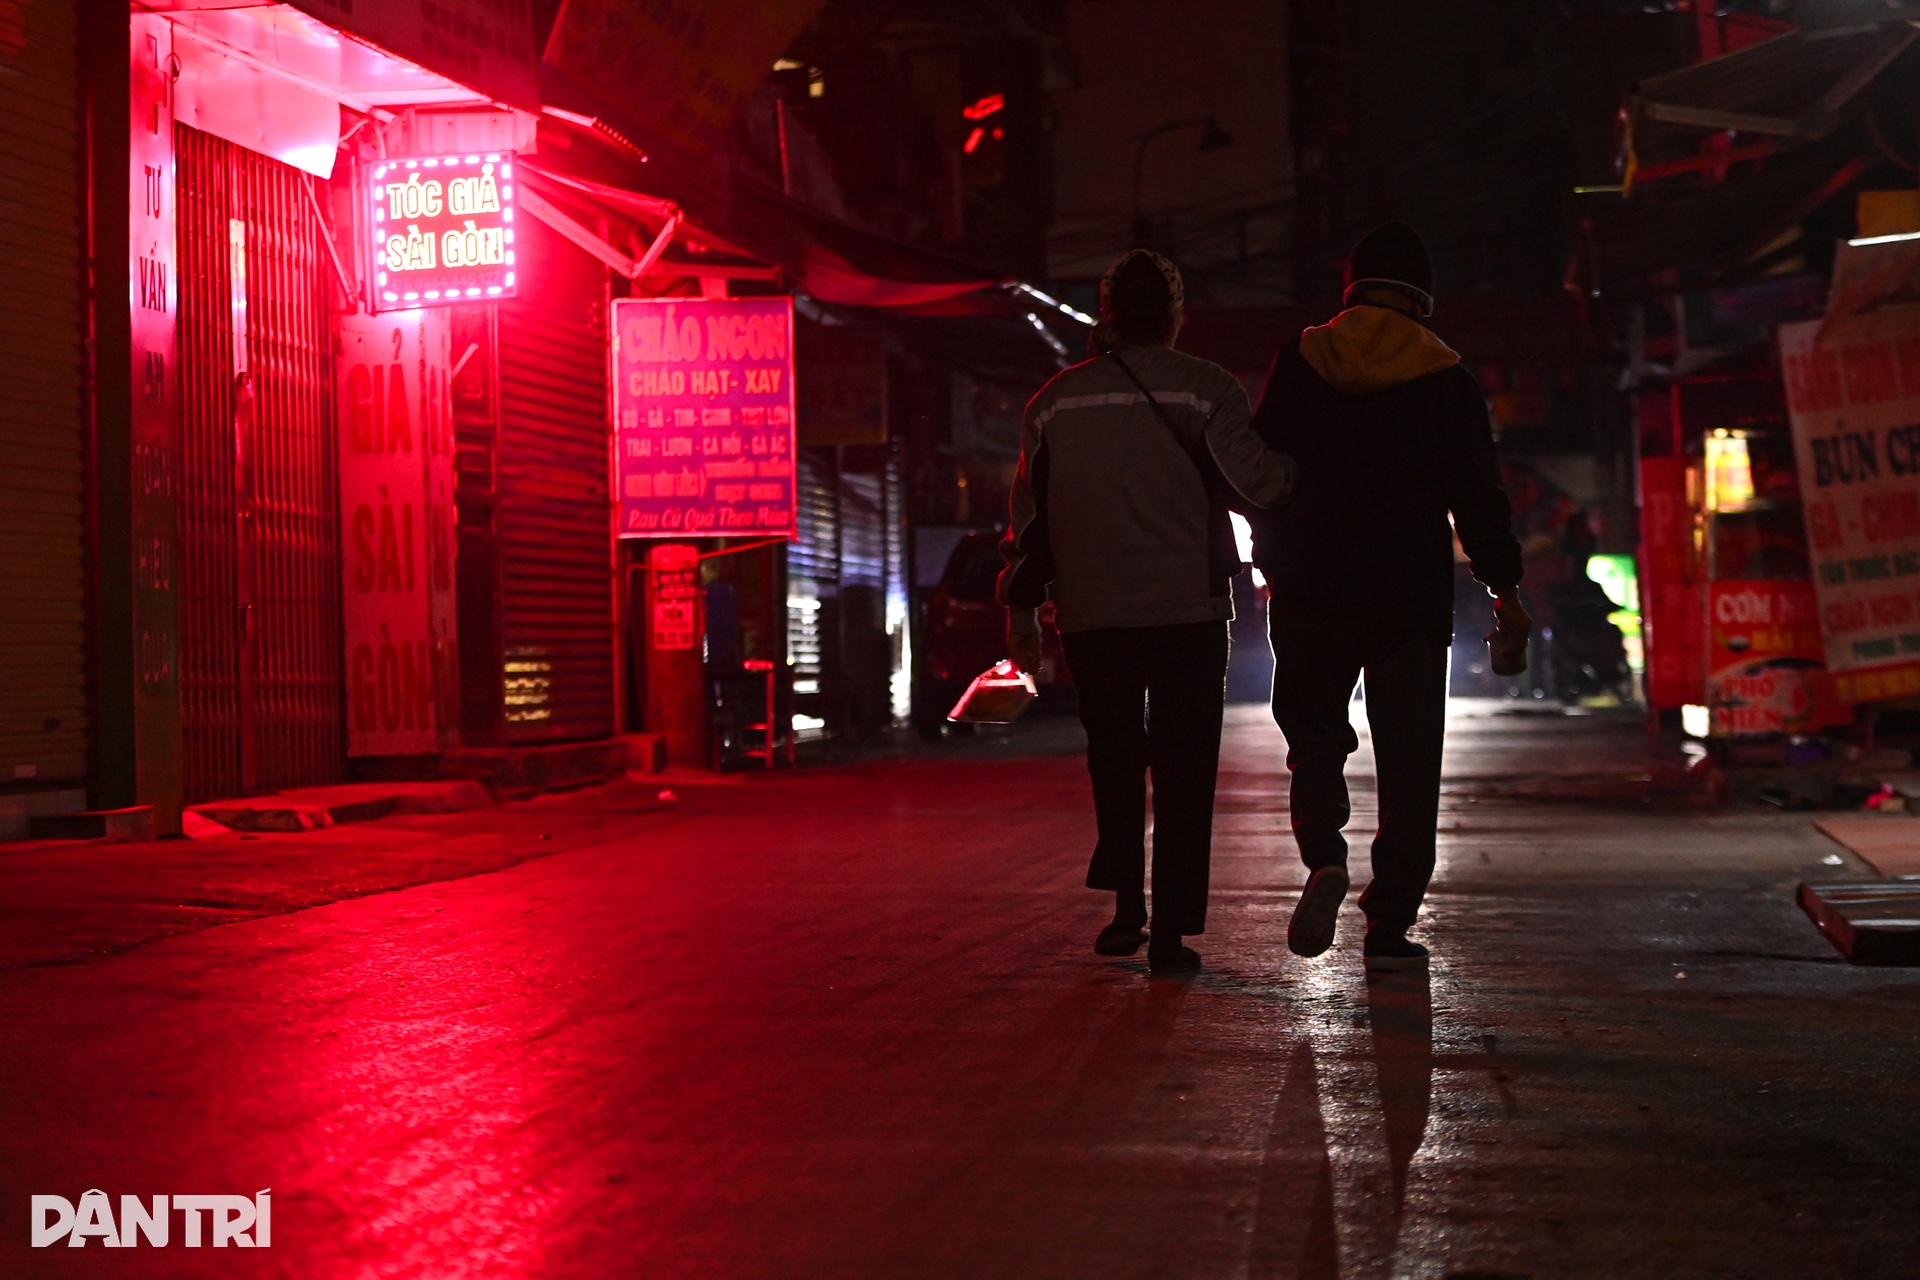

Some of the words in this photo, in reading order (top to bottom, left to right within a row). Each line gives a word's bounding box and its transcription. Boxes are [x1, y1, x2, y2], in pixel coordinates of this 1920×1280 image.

[386, 173, 443, 220] TÓC
[448, 163, 501, 216] GIẢ
[386, 225, 437, 272] SÀI
[442, 220, 504, 268] GÒN
[622, 304, 700, 363] CHÁO
[705, 314, 787, 361] NGON
[348, 328, 412, 454] GIẢ
[630, 366, 685, 396] CHÁO
[745, 369, 781, 394] XAY
[1812, 420, 1879, 488] BÚN
[353, 484, 415, 593] SÀI
[352, 623, 429, 734] GÒN
